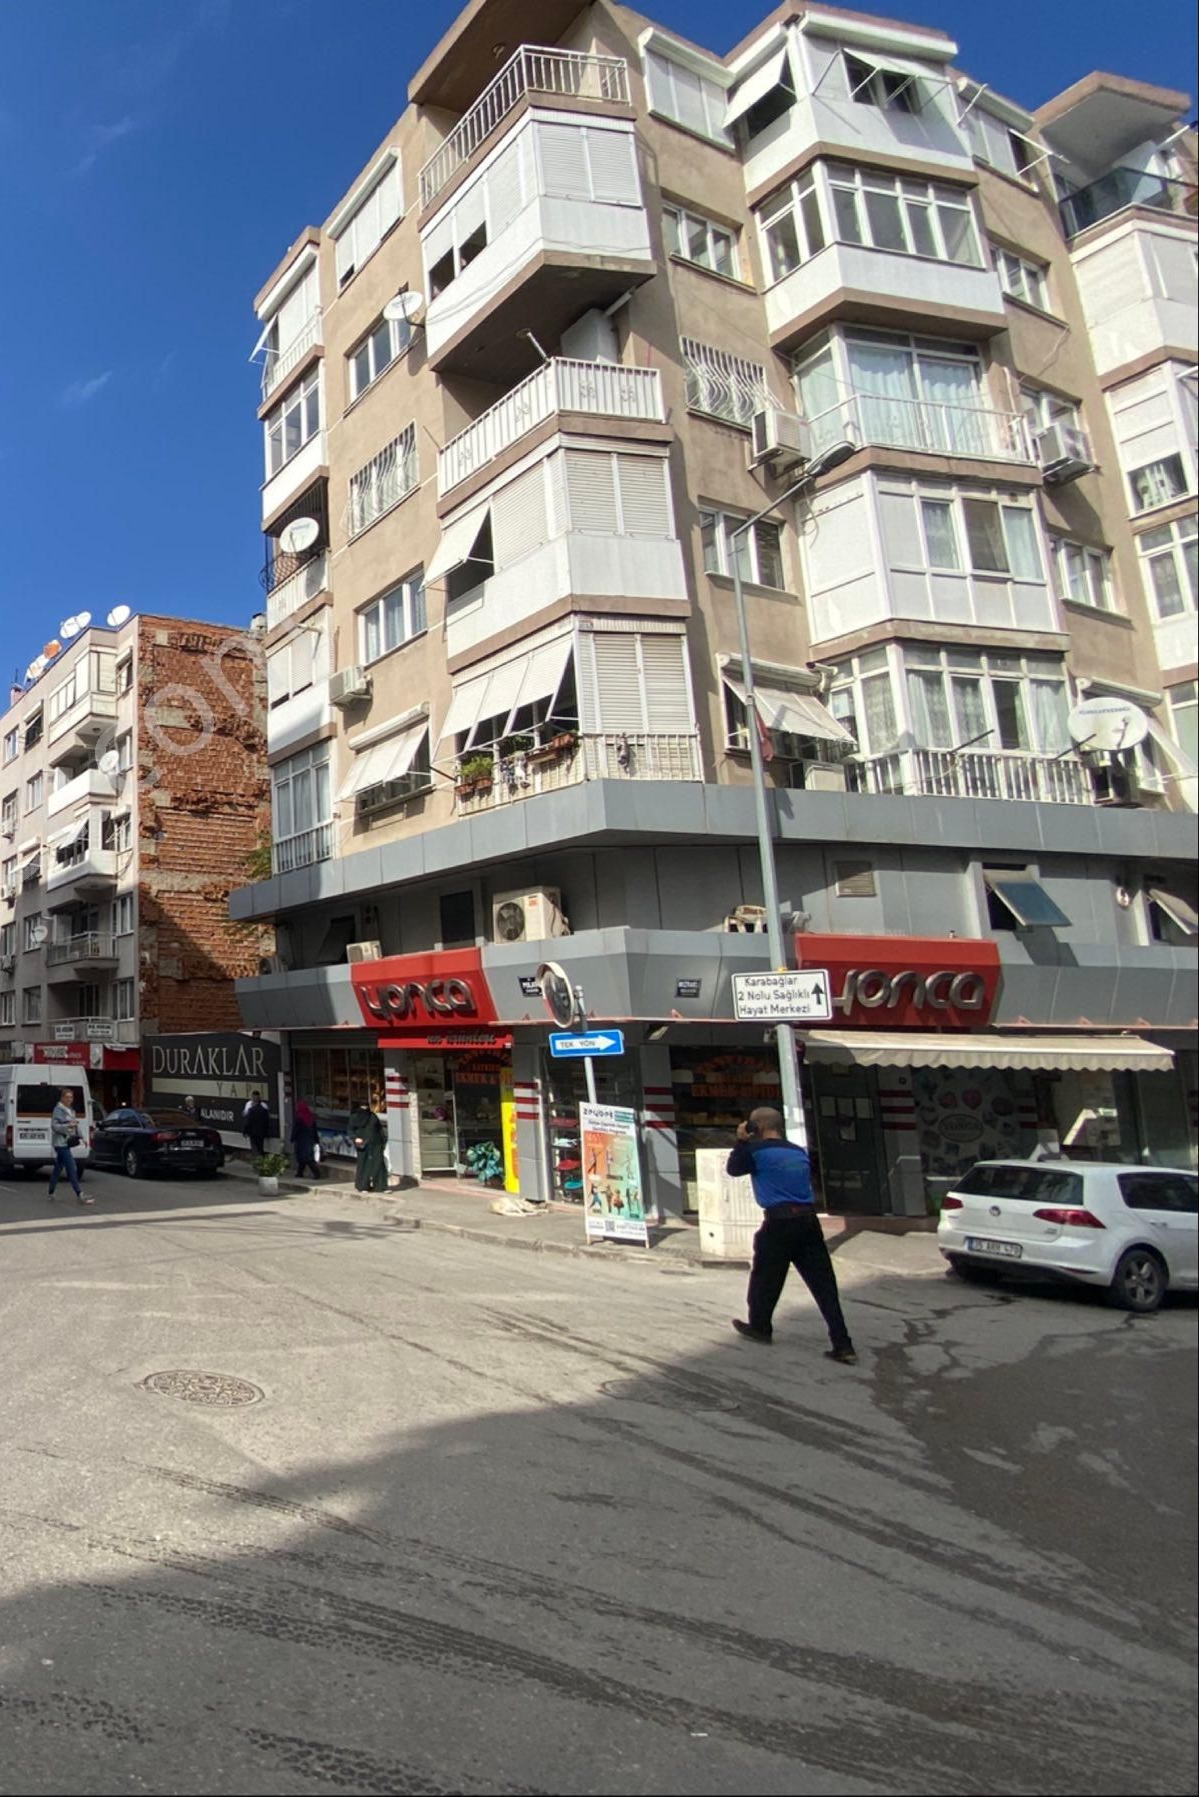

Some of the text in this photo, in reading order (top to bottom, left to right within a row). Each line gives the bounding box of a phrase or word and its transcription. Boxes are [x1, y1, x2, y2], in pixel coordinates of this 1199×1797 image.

[744, 976, 798, 988] Karabağlar
[361, 978, 477, 1021] yonca
[738, 989, 810, 1002] 2 Nolu Sağlıklı
[740, 1003, 811, 1017] Hayat Merkezi
[152, 1044, 269, 1077] DURAKLAR
